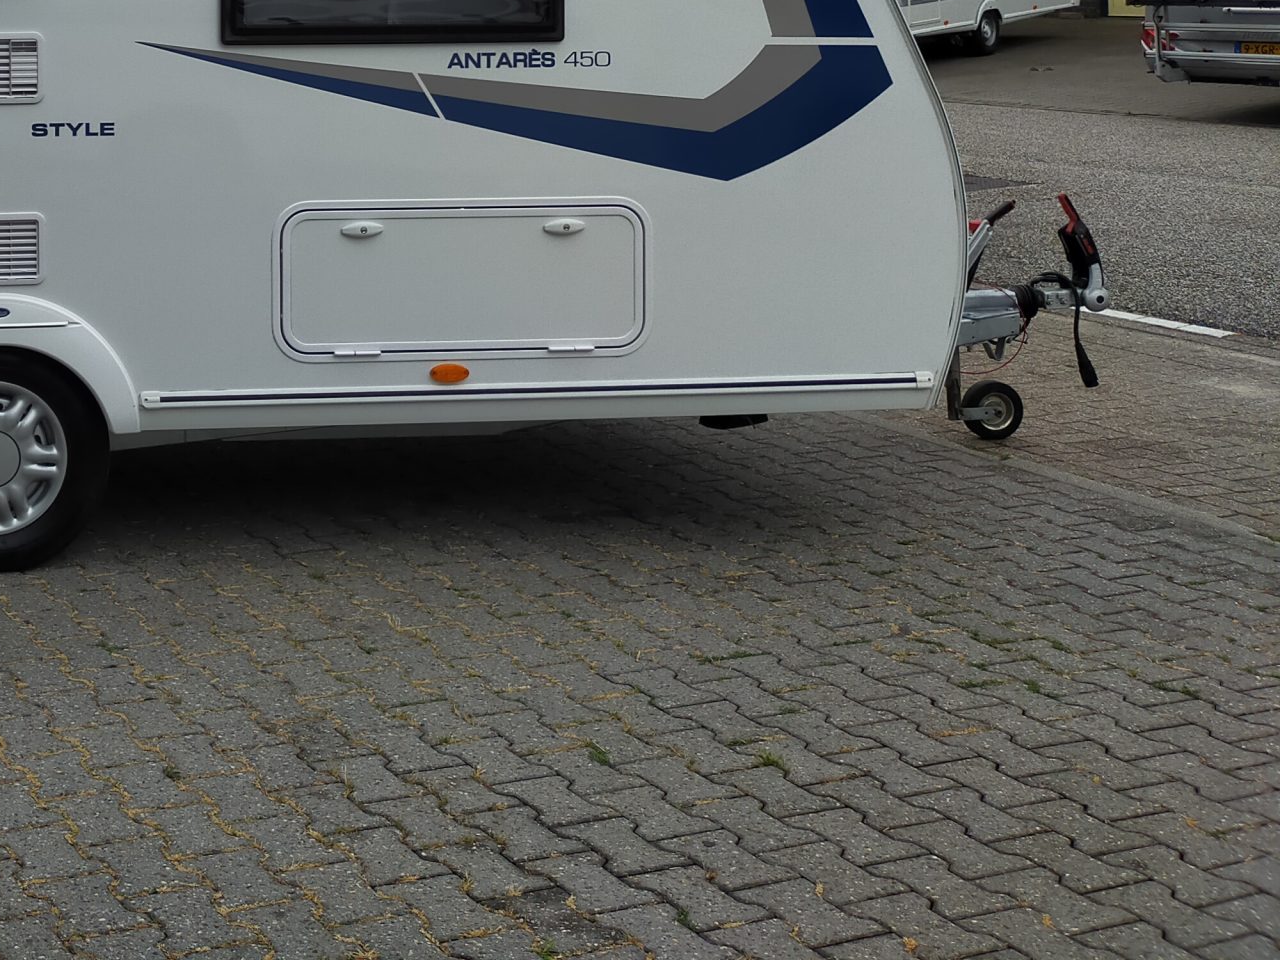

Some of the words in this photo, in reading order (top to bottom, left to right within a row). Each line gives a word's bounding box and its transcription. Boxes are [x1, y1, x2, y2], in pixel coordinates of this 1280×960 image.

[447, 48, 556, 69] ANTARÈS
[563, 51, 611, 67] 450
[31, 122, 115, 137] STYLE
